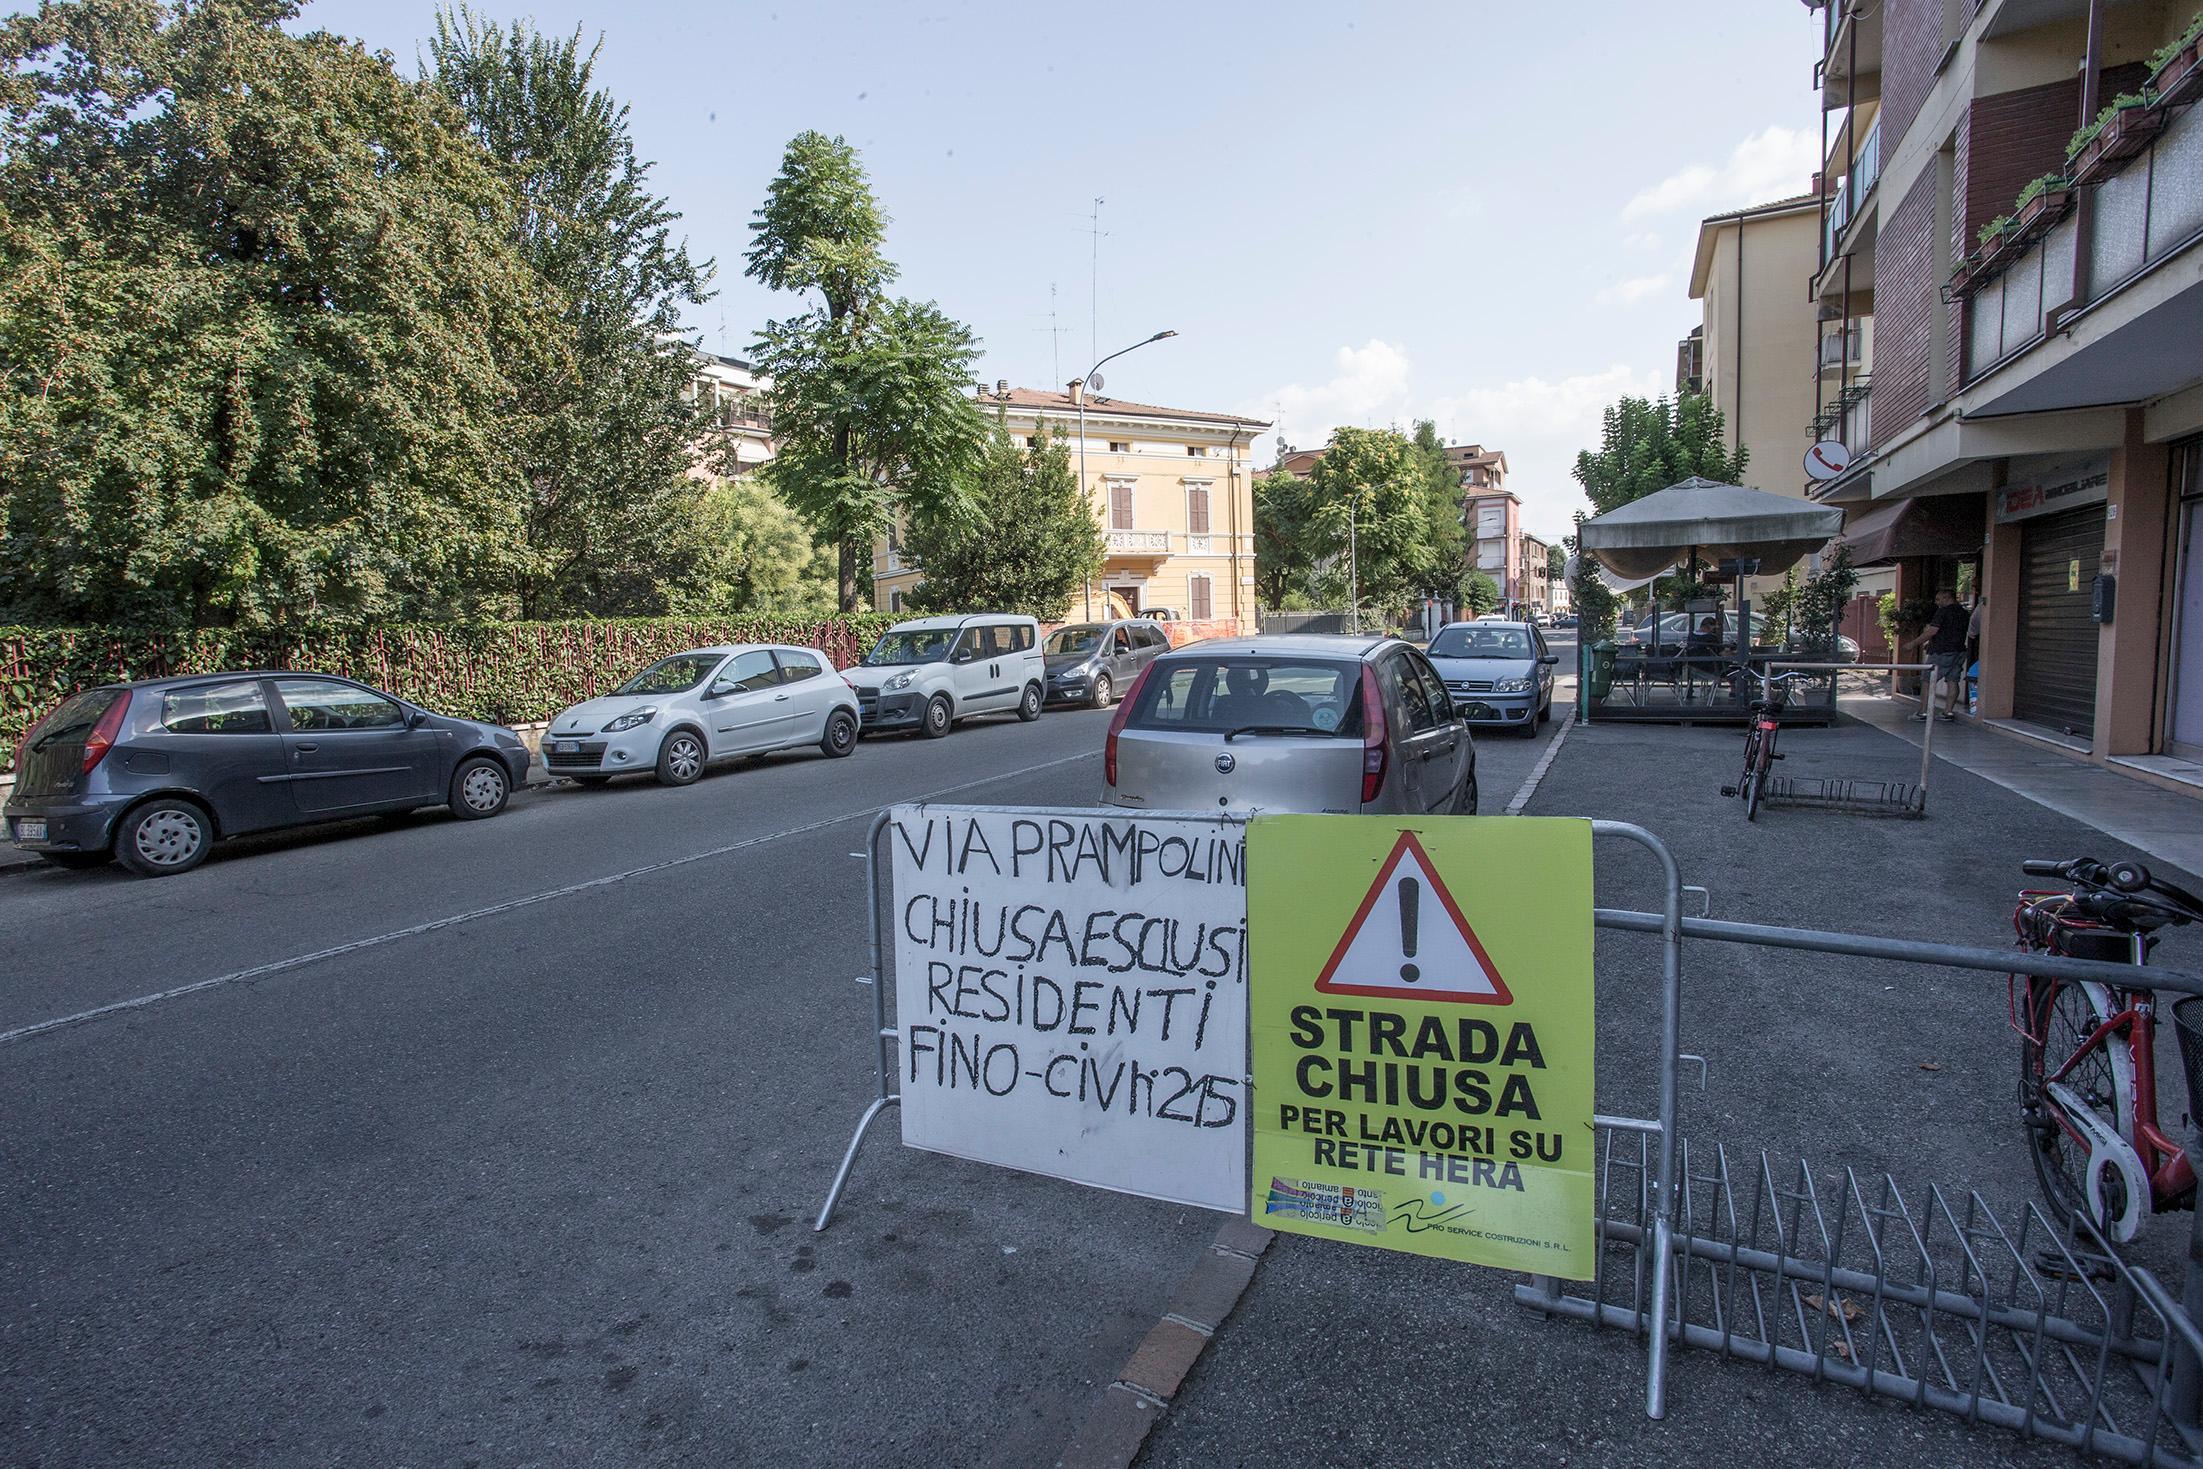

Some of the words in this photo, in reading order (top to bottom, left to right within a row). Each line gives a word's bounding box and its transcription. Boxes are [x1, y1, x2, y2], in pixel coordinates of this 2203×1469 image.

[898, 815, 1001, 876] VIA
[1011, 818, 1247, 887] PRAMPOLINI
[928, 961, 1216, 1051] RESIDENTI
[1290, 1005, 1547, 1069] STRADA
[1296, 1055, 1542, 1120] CHIUSA
[1280, 1104, 1346, 1138] PER
[1360, 1114, 1495, 1154] LAVORI
[1509, 1131, 1562, 1162] SU
[1302, 1180, 1339, 1193] amianto
[1314, 1137, 1406, 1176] RETE
[1420, 1151, 1525, 1193] HERA
[1300, 1209, 1337, 1222] pericolo
[1301, 1191, 1339, 1204] pericolo
[1427, 1223, 1445, 1232] PRO
[1447, 1226, 1483, 1238] SERVICE
[1485, 1232, 1541, 1247] COSTRUZIONI
[1544, 1241, 1572, 1252] S.R.L.
